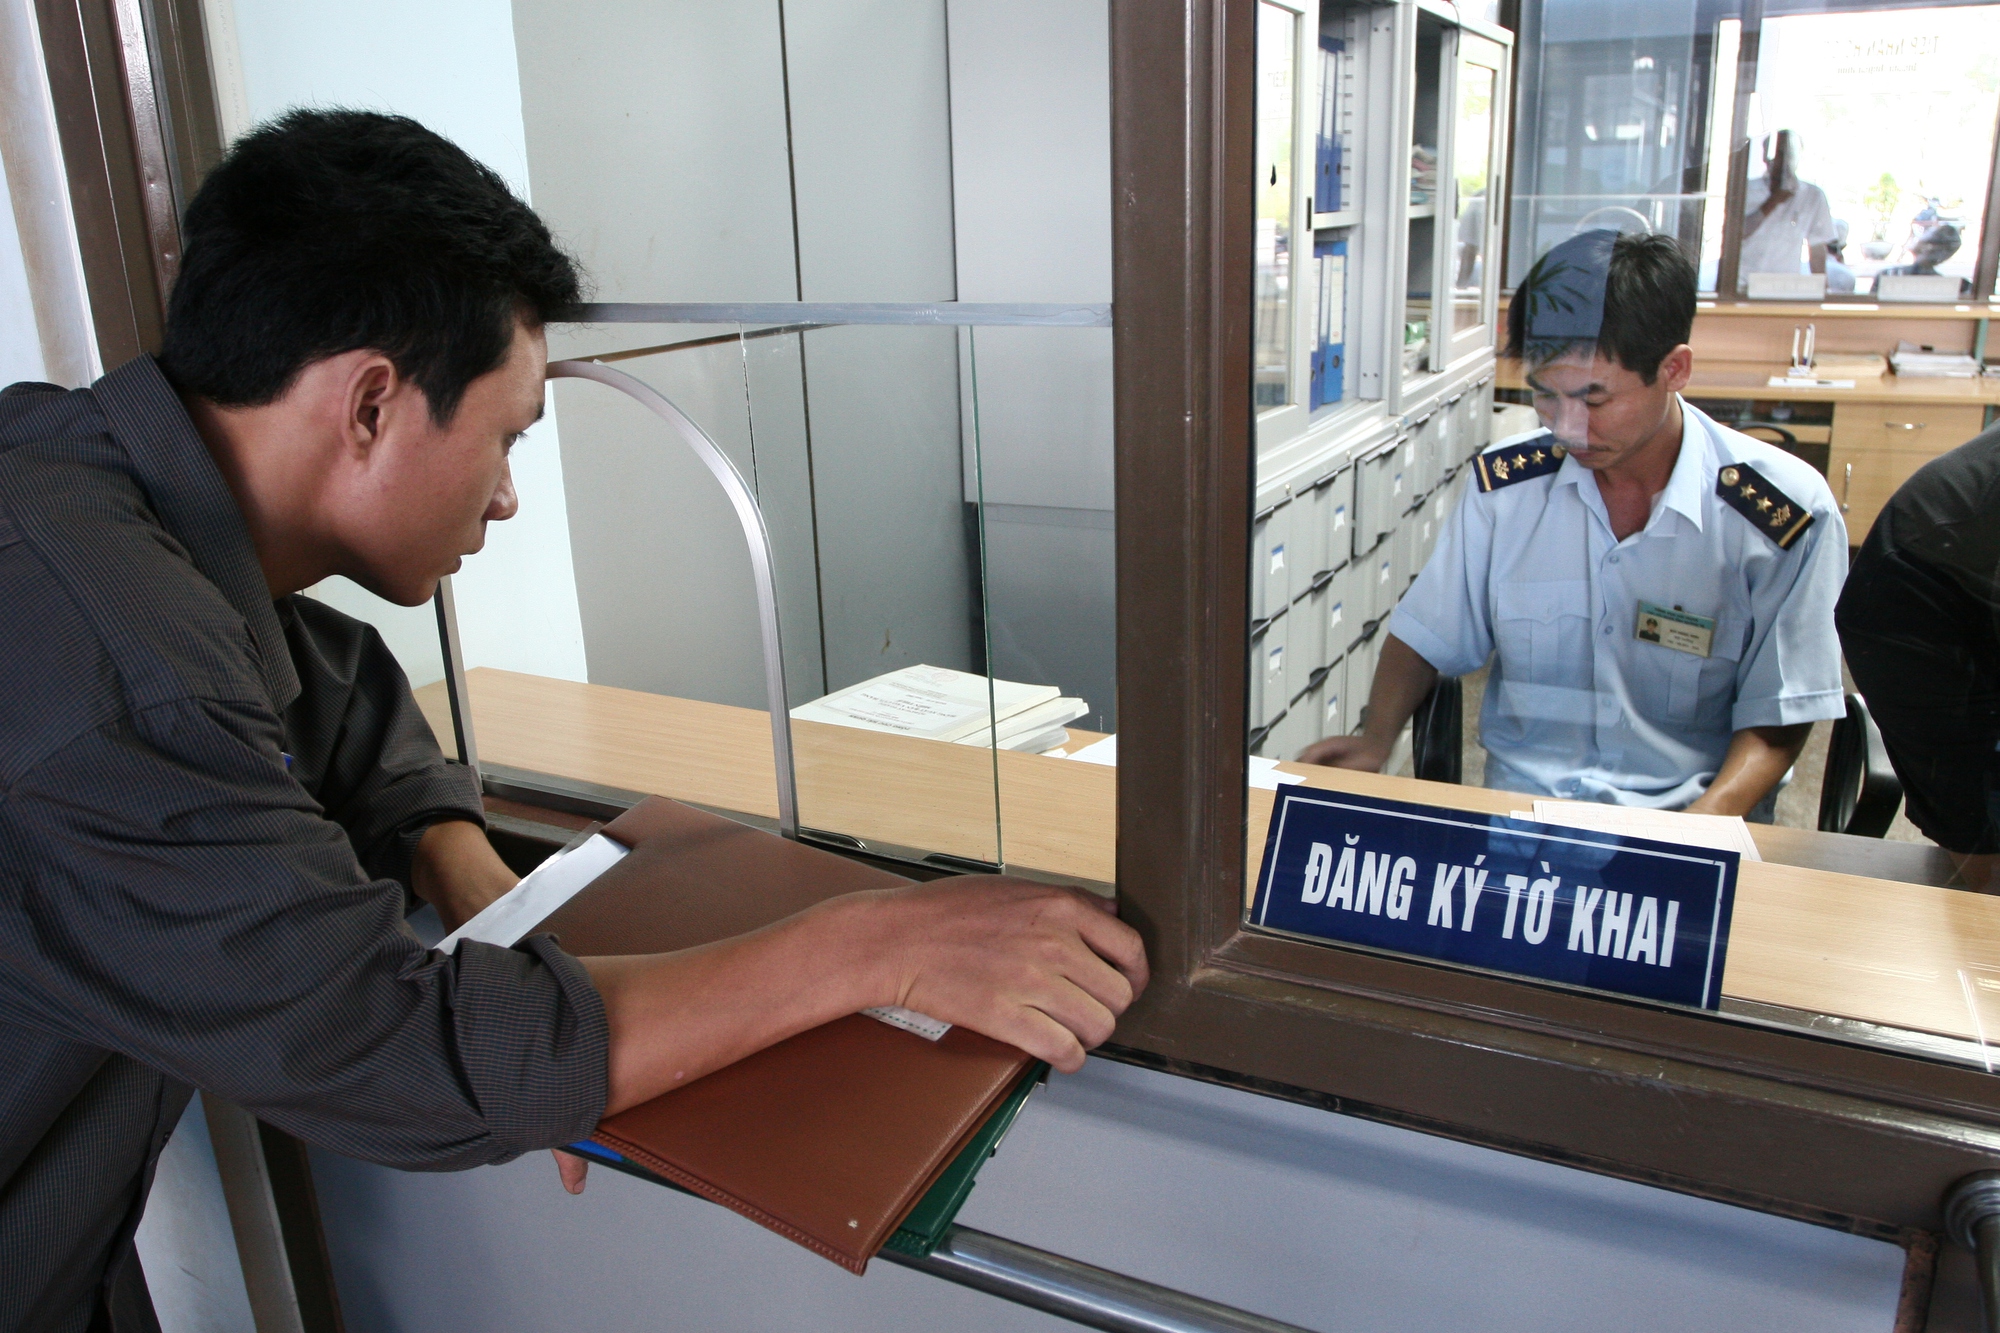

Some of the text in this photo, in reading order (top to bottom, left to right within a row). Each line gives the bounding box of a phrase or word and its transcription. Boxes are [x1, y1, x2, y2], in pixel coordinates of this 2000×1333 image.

[1301, 833, 1680, 968] ĐĂNG KÝ TỜ KHAI
